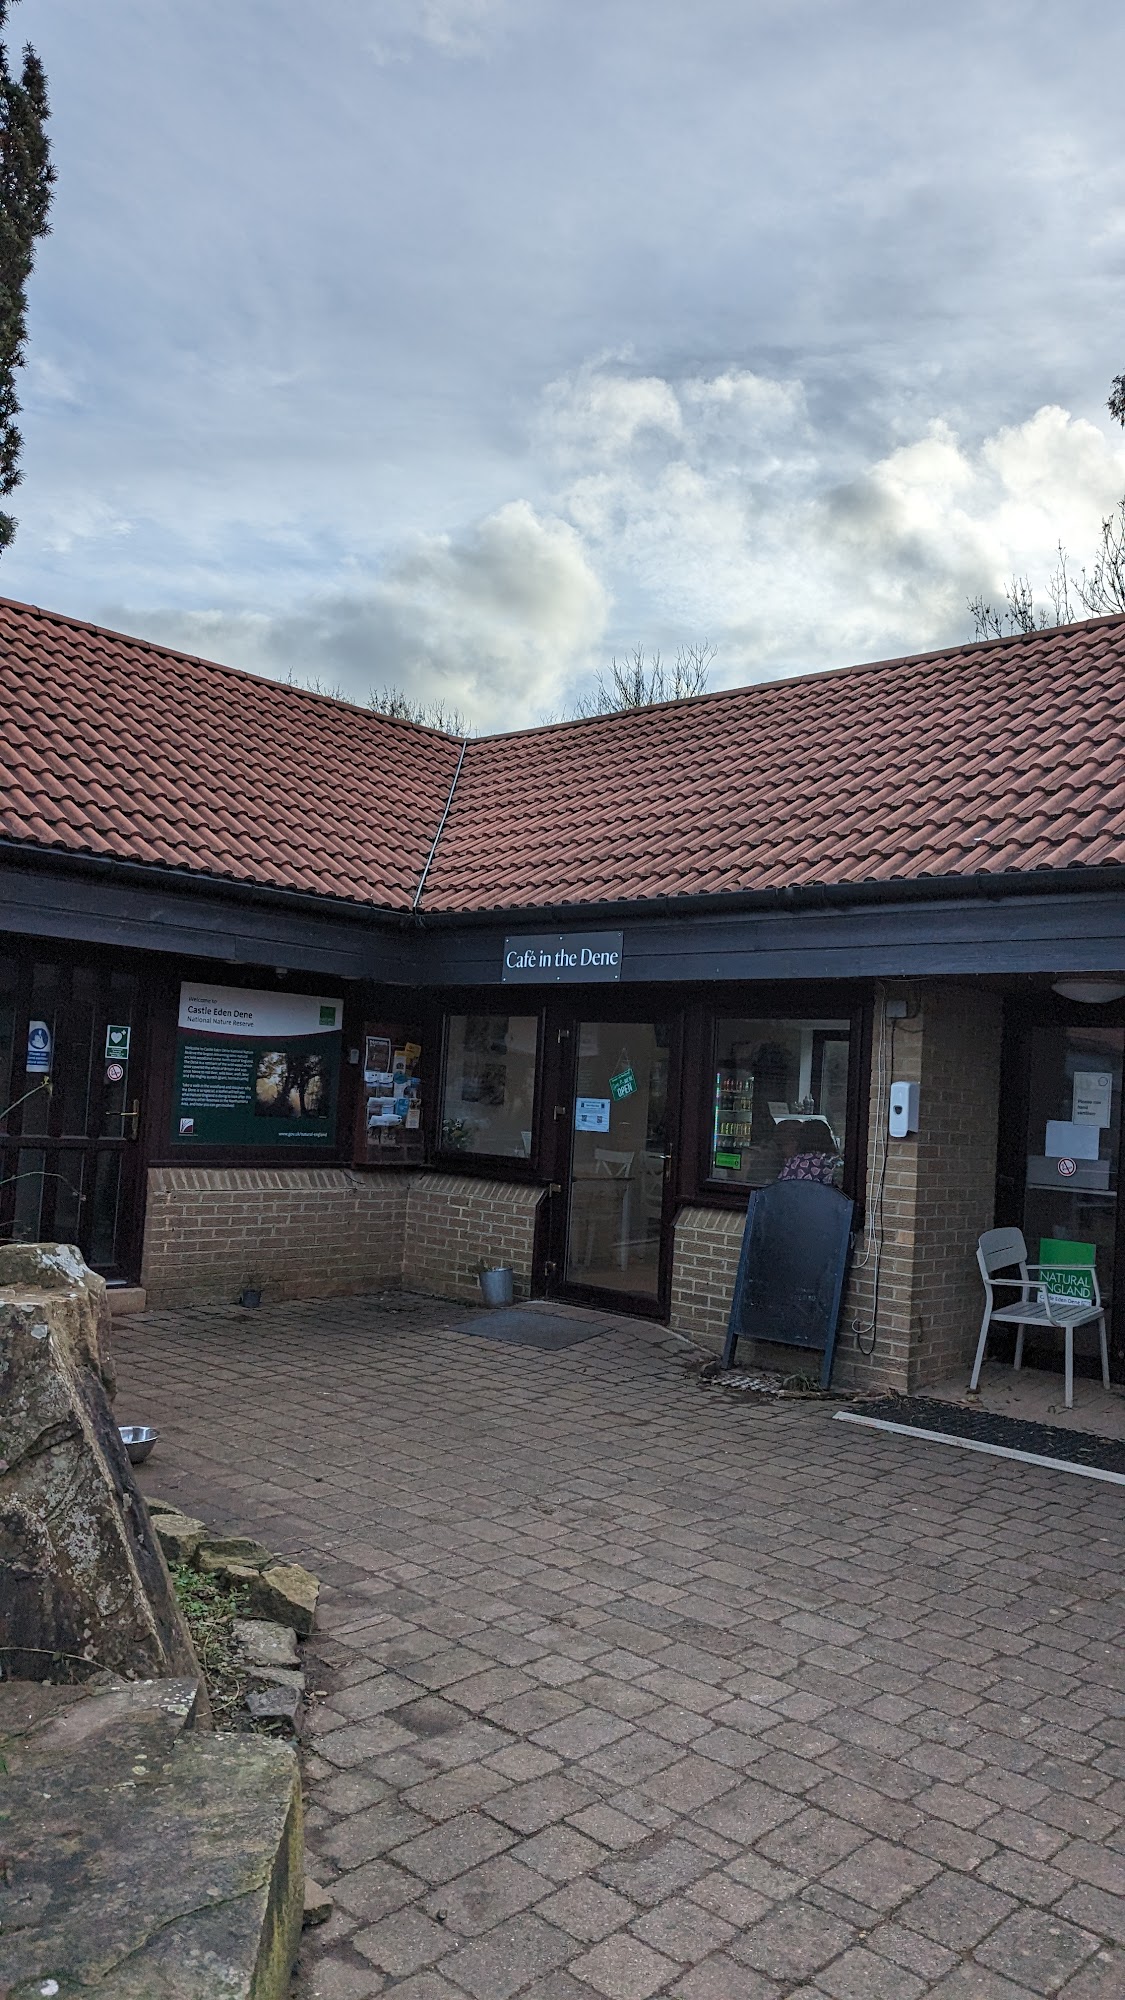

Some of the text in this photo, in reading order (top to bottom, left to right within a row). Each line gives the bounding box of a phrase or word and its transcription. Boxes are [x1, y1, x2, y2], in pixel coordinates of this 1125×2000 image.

[506, 948, 619, 968] Café in the Dene
[188, 1006, 252, 1018] Castle Eden Dene
[187, 1016, 212, 1024] National
[617, 1082, 633, 1097] OPEN
[1040, 1272, 1090, 1287] NATURAL
[1040, 1284, 1090, 1298] NGLAND
